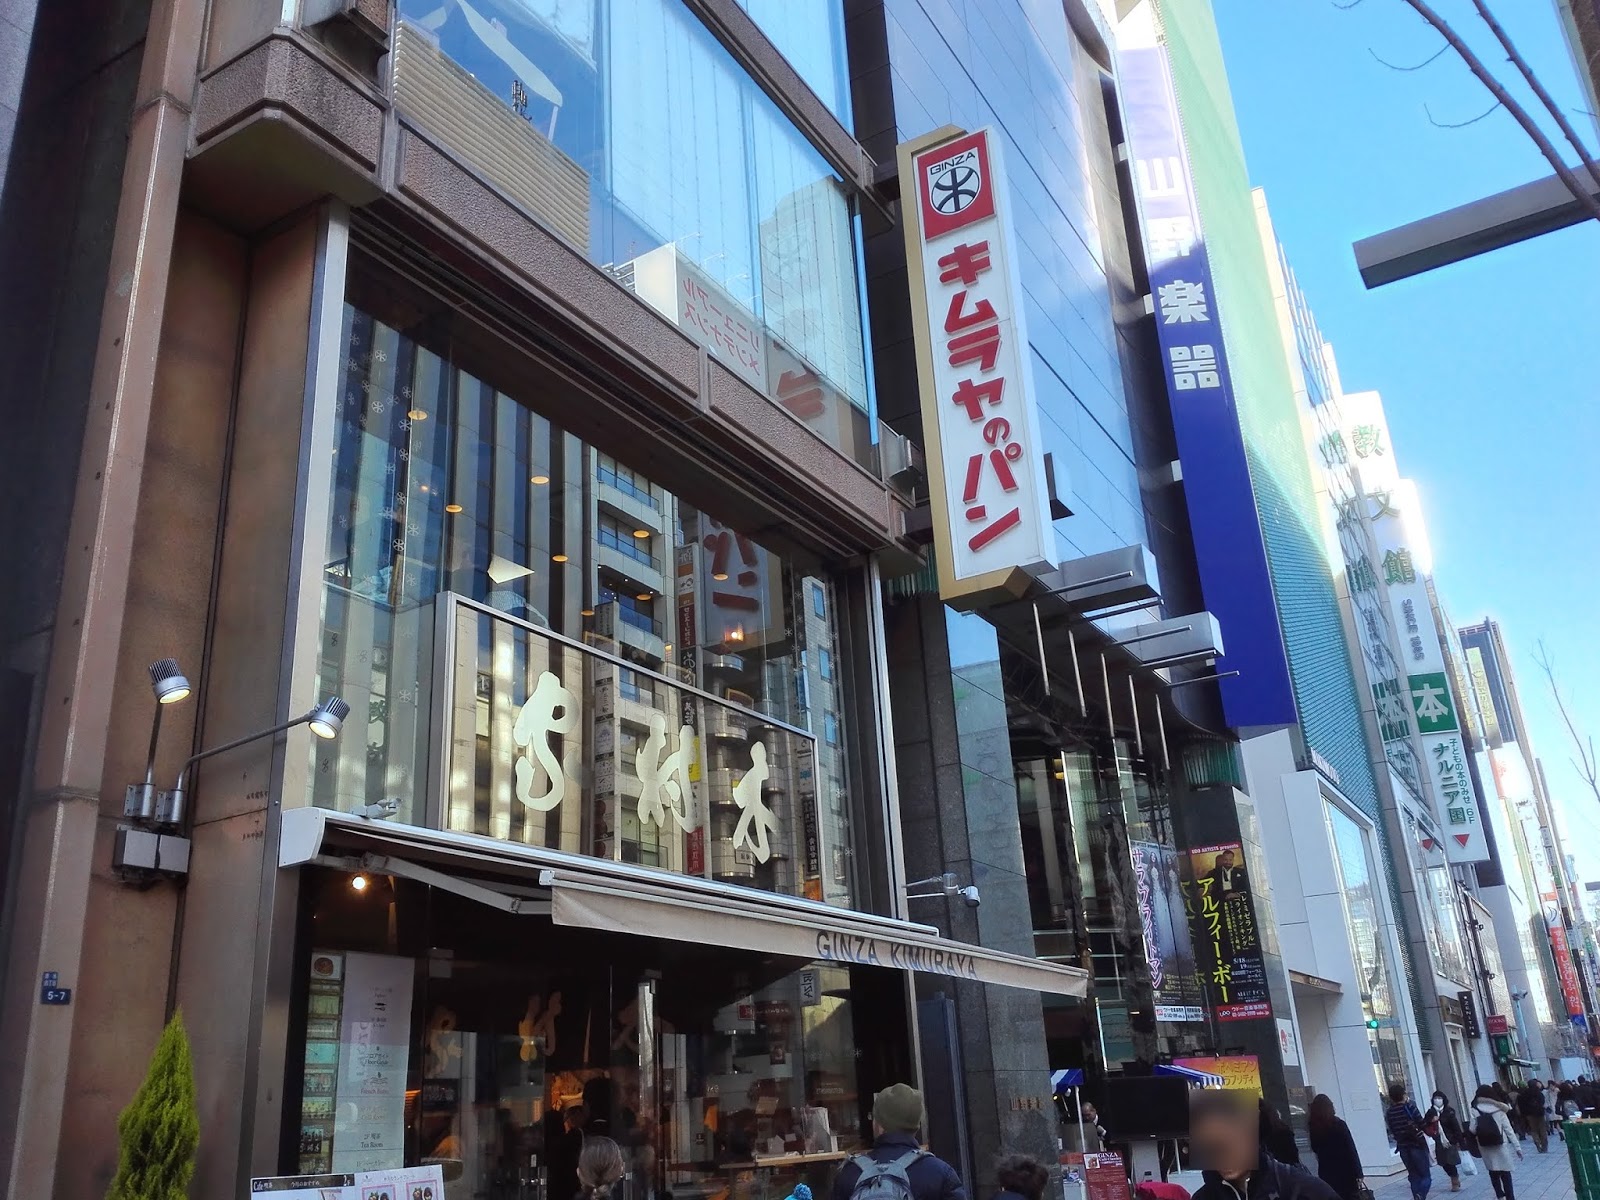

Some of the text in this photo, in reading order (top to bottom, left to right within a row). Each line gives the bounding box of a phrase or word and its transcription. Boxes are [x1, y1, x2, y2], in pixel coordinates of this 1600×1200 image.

[930, 152, 976, 175] GINZA
[938, 240, 1022, 552] キムラヤのパン
[1352, 424, 1416, 586] 教文館
[1402, 598, 1418, 634] SINCE
[1412, 683, 1450, 724] 本
[1433, 742, 1466, 826] ナルニア国
[1449, 738, 1471, 804] 子どもの本のみせ
[1466, 808, 1475, 824] 6F
[816, 931, 978, 979] GINZA KIMURAYA
[1197, 877, 1232, 1003] アルフィー・ボー
[47, 991, 66, 1000] 5-7
[1464, 1000, 1475, 1030] ZENITH
[1217, 1061, 1257, 1074] ボヘミアン
